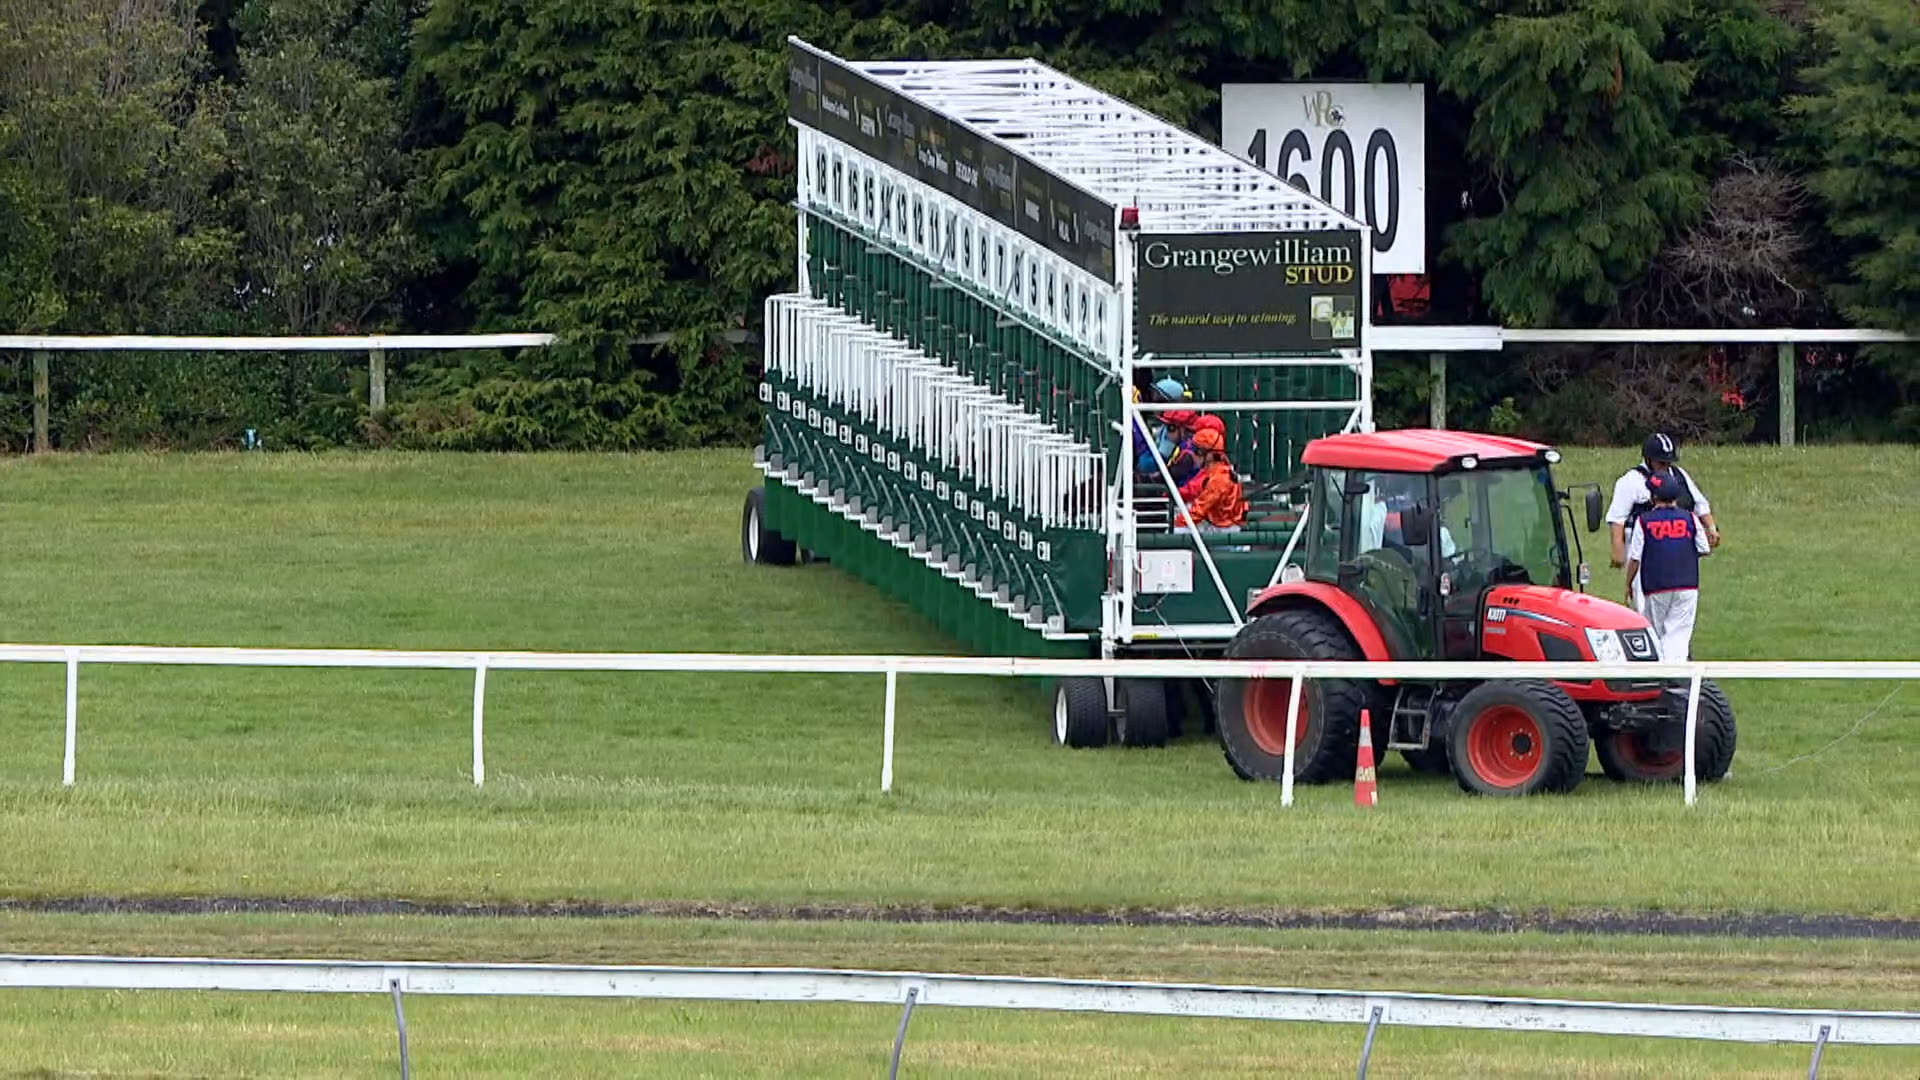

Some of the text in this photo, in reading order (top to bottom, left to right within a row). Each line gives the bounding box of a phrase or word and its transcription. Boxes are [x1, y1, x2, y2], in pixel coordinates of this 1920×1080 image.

[832, 160, 841, 204] 17
[848, 168, 858, 212] 16
[864, 175, 874, 219] 15
[930, 208, 939, 255] 11
[964, 226, 971, 269] 9
[980, 234, 988, 279] 8
[1030, 262, 1038, 306] 5
[1064, 281, 1071, 324] 3
[1080, 290, 1088, 336] 2
[1145, 239, 1351, 274] Grangewilliam
[1284, 265, 1354, 285] STUD
[1150, 312, 1169, 326] The
[1171, 312, 1210, 325] natural
[1212, 314, 1235, 327] way
[1236, 313, 1248, 323] to
